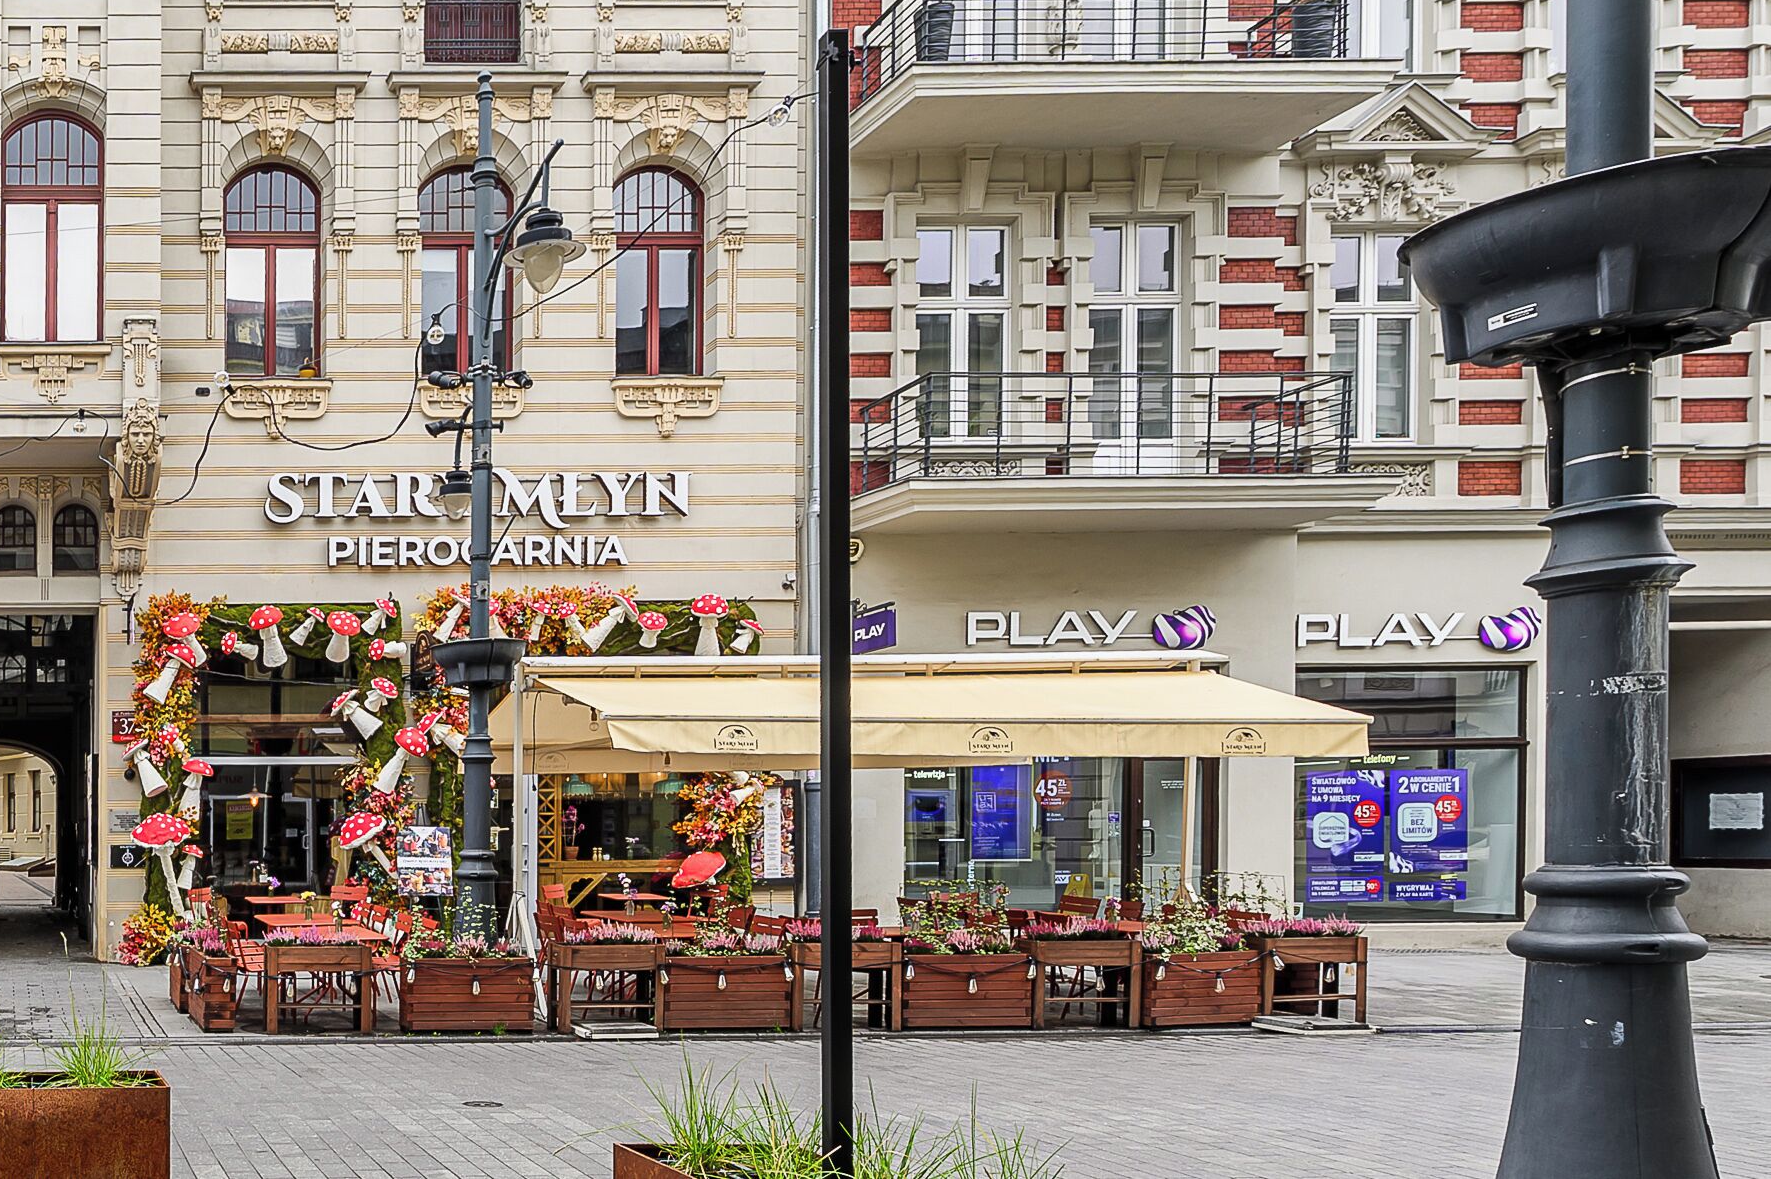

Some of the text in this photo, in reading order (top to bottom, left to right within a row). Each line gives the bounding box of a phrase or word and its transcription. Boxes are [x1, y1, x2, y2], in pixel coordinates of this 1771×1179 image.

[264, 468, 693, 530] STAR MŁYN
[854, 622, 885, 642] PLAY
[966, 610, 1138, 647] PLAY
[1296, 612, 1466, 648] PLAY
[1363, 754, 1396, 764] telefony
[914, 770, 946, 780] telewizja
[1035, 779, 1057, 796] 45
[1398, 777, 1409, 793] 2
[1410, 776, 1460, 792] W CENIE 1
[1354, 805, 1369, 818] 45
[1436, 800, 1451, 813] 45
[1402, 826, 1432, 834] LIMITÓW
